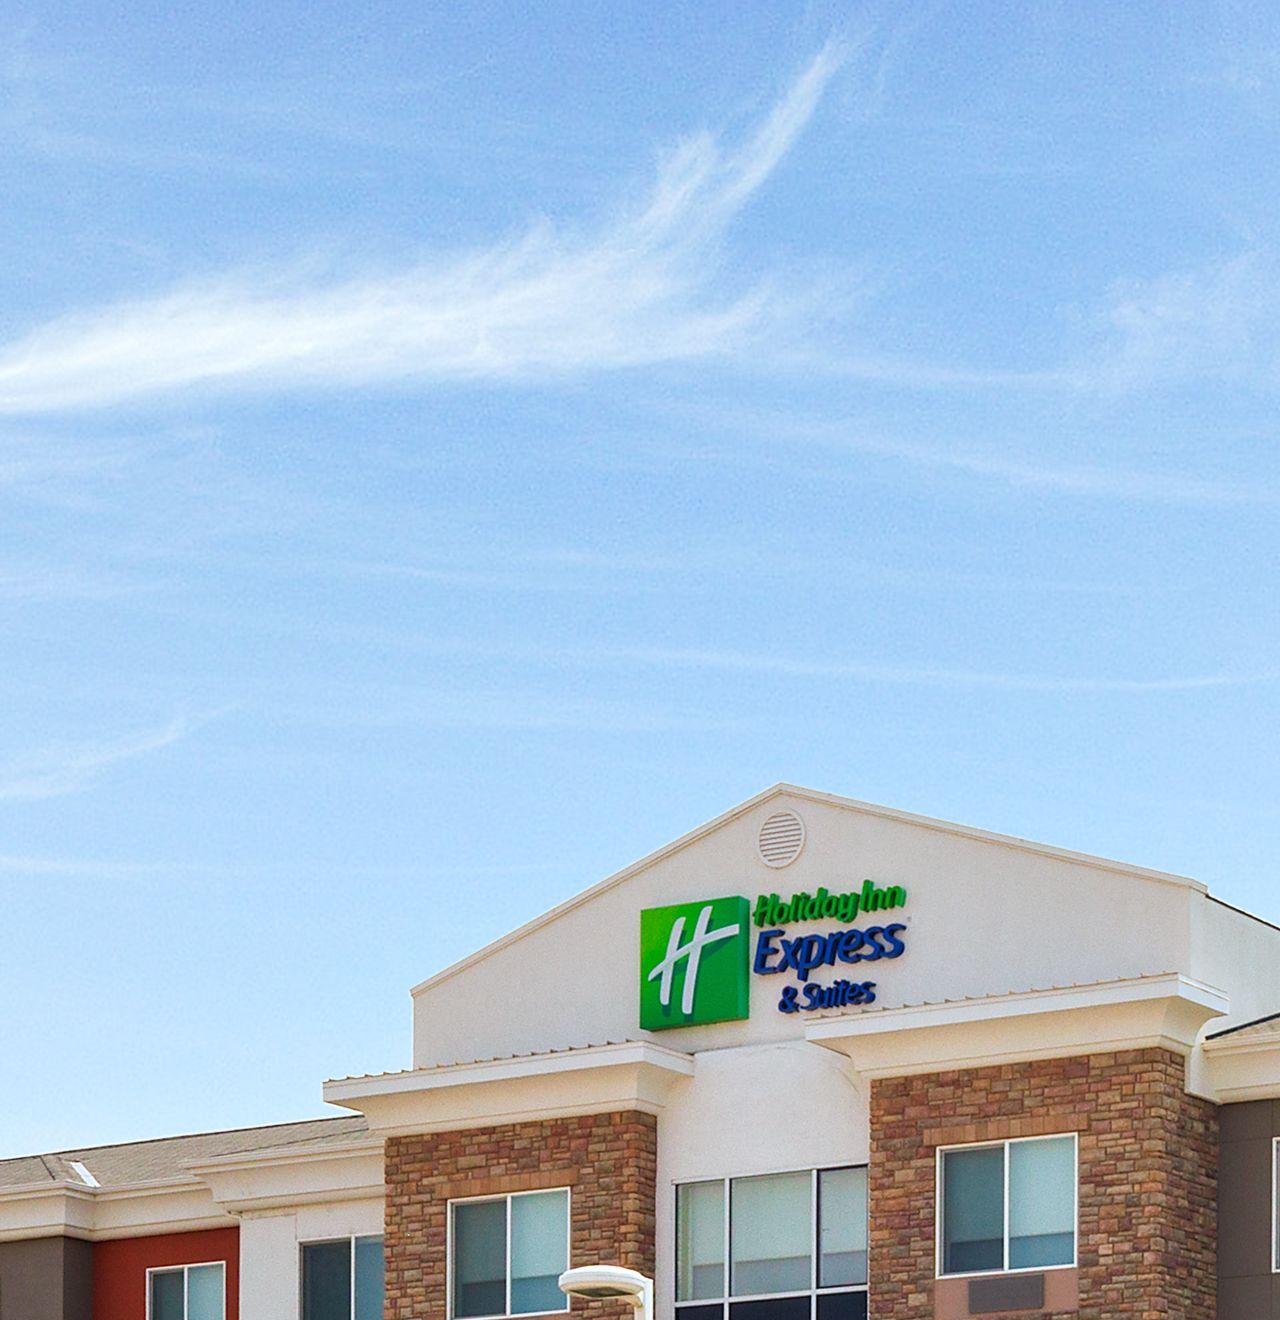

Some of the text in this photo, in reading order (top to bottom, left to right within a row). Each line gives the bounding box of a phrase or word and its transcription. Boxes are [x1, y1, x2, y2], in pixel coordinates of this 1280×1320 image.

[752, 879, 907, 928] Holiday Inn
[753, 923, 907, 982] Express
[778, 979, 877, 1014] & Suites
